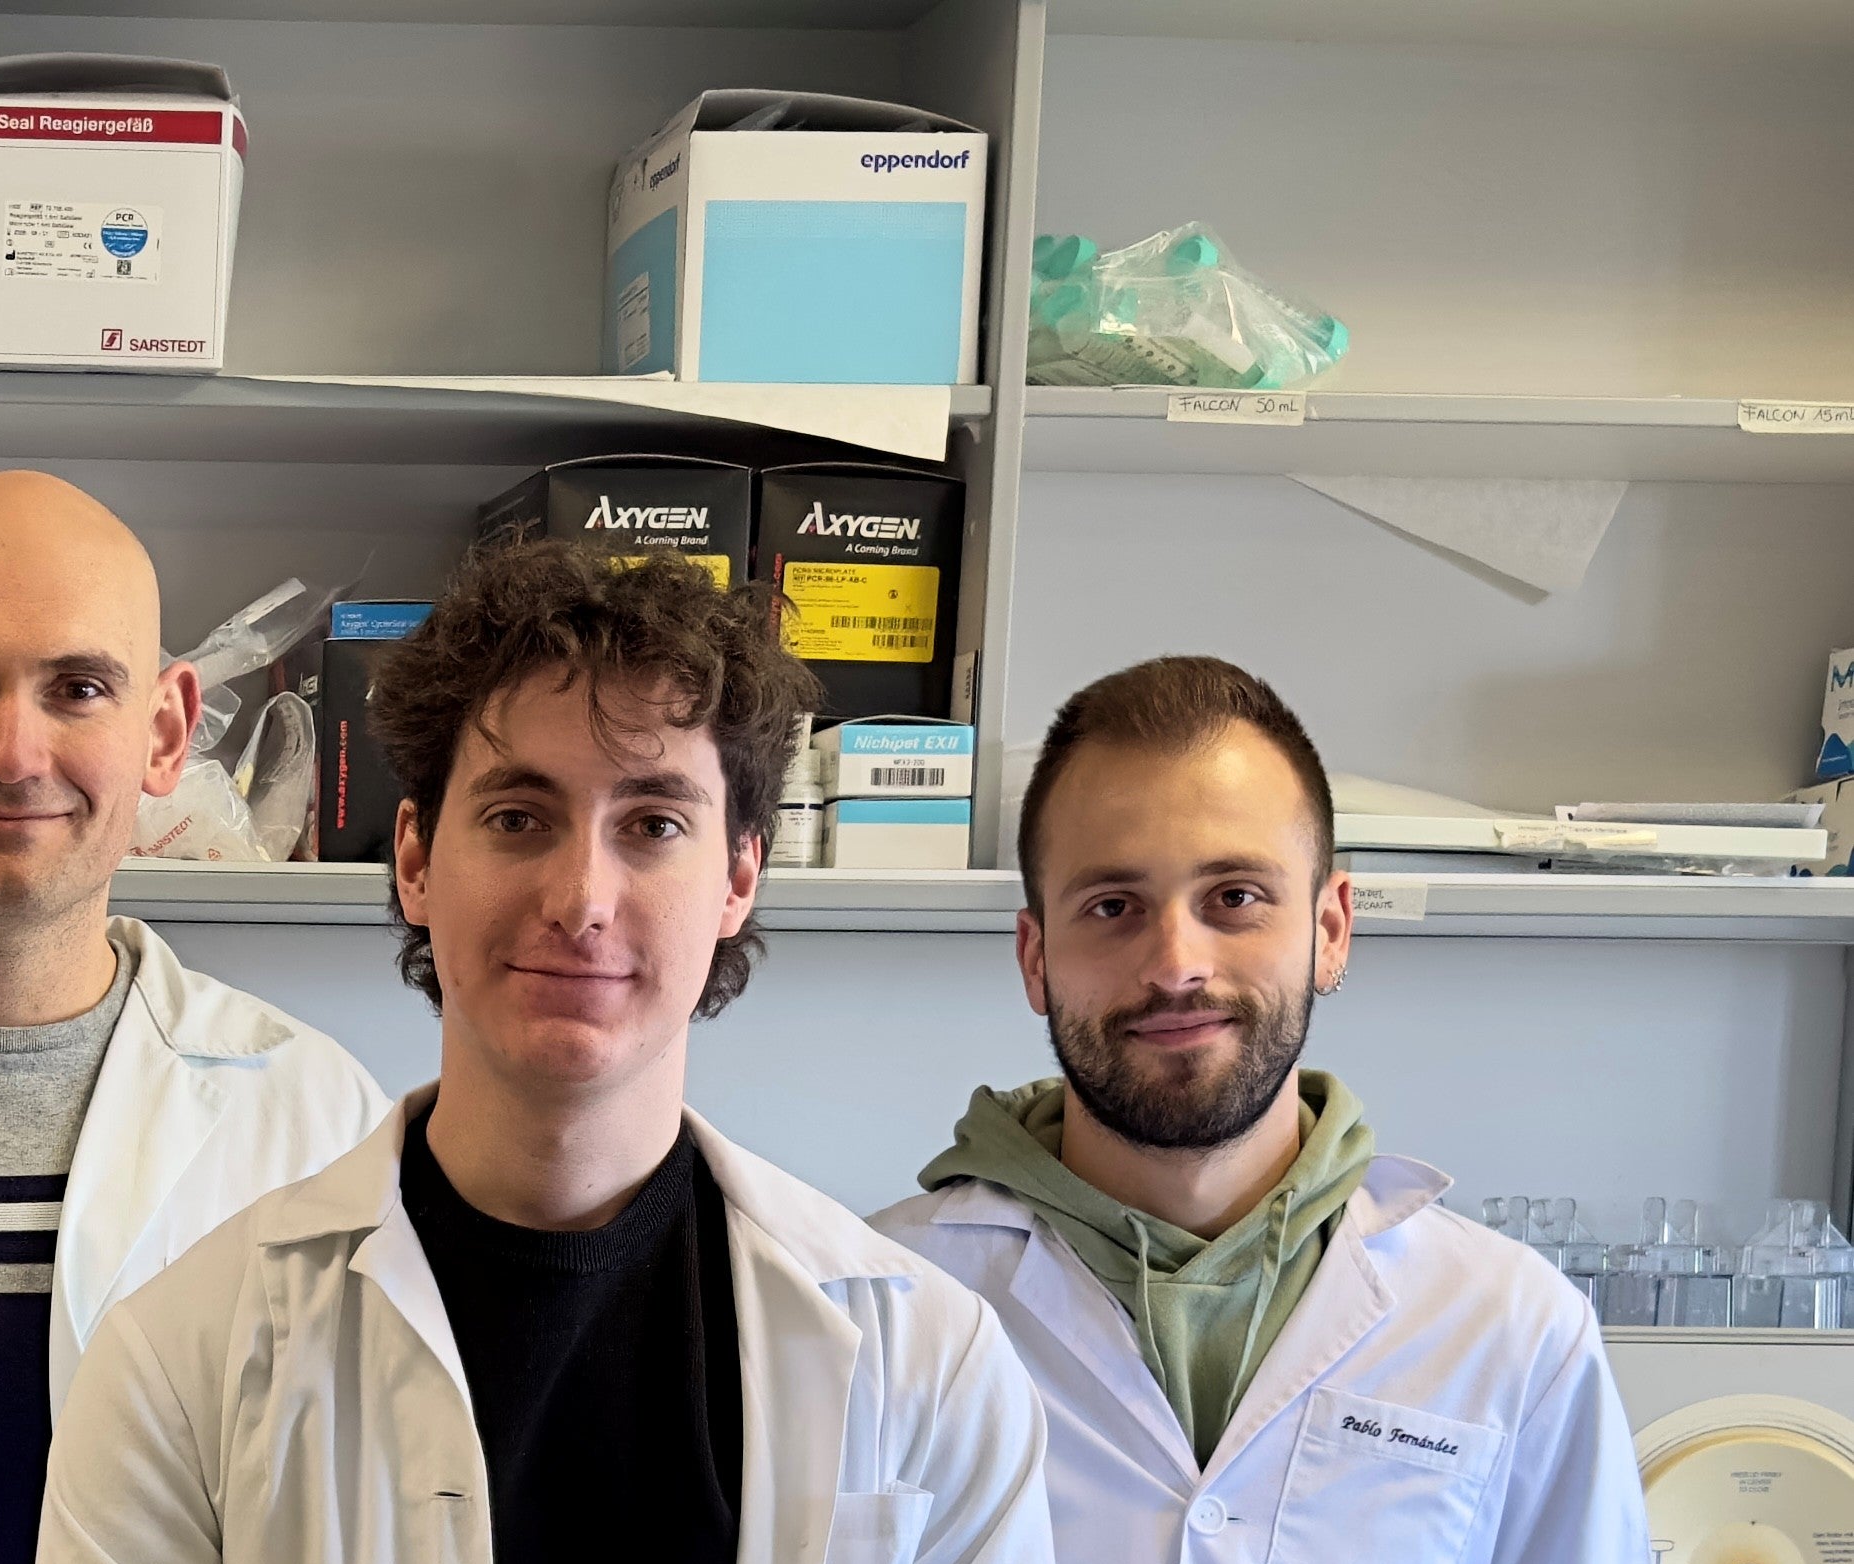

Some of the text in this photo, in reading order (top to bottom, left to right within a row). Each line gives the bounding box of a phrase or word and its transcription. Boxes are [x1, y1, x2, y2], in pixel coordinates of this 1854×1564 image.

[38, 115, 155, 136] Reagiergefäß
[860, 149, 971, 174] eppendorf
[128, 338, 207, 354] SARSTEDT
[1178, 395, 1242, 412] FALCON
[1743, 405, 1806, 422] FALCON
[584, 495, 710, 530] AXYGEN
[796, 501, 921, 540] AXYGEN
[634, 535, 709, 548] A Corning Brand
[845, 543, 920, 557] A Corning Brand
[853, 734, 920, 752] Nichipet
[1340, 1415, 1382, 1438] Pablo
